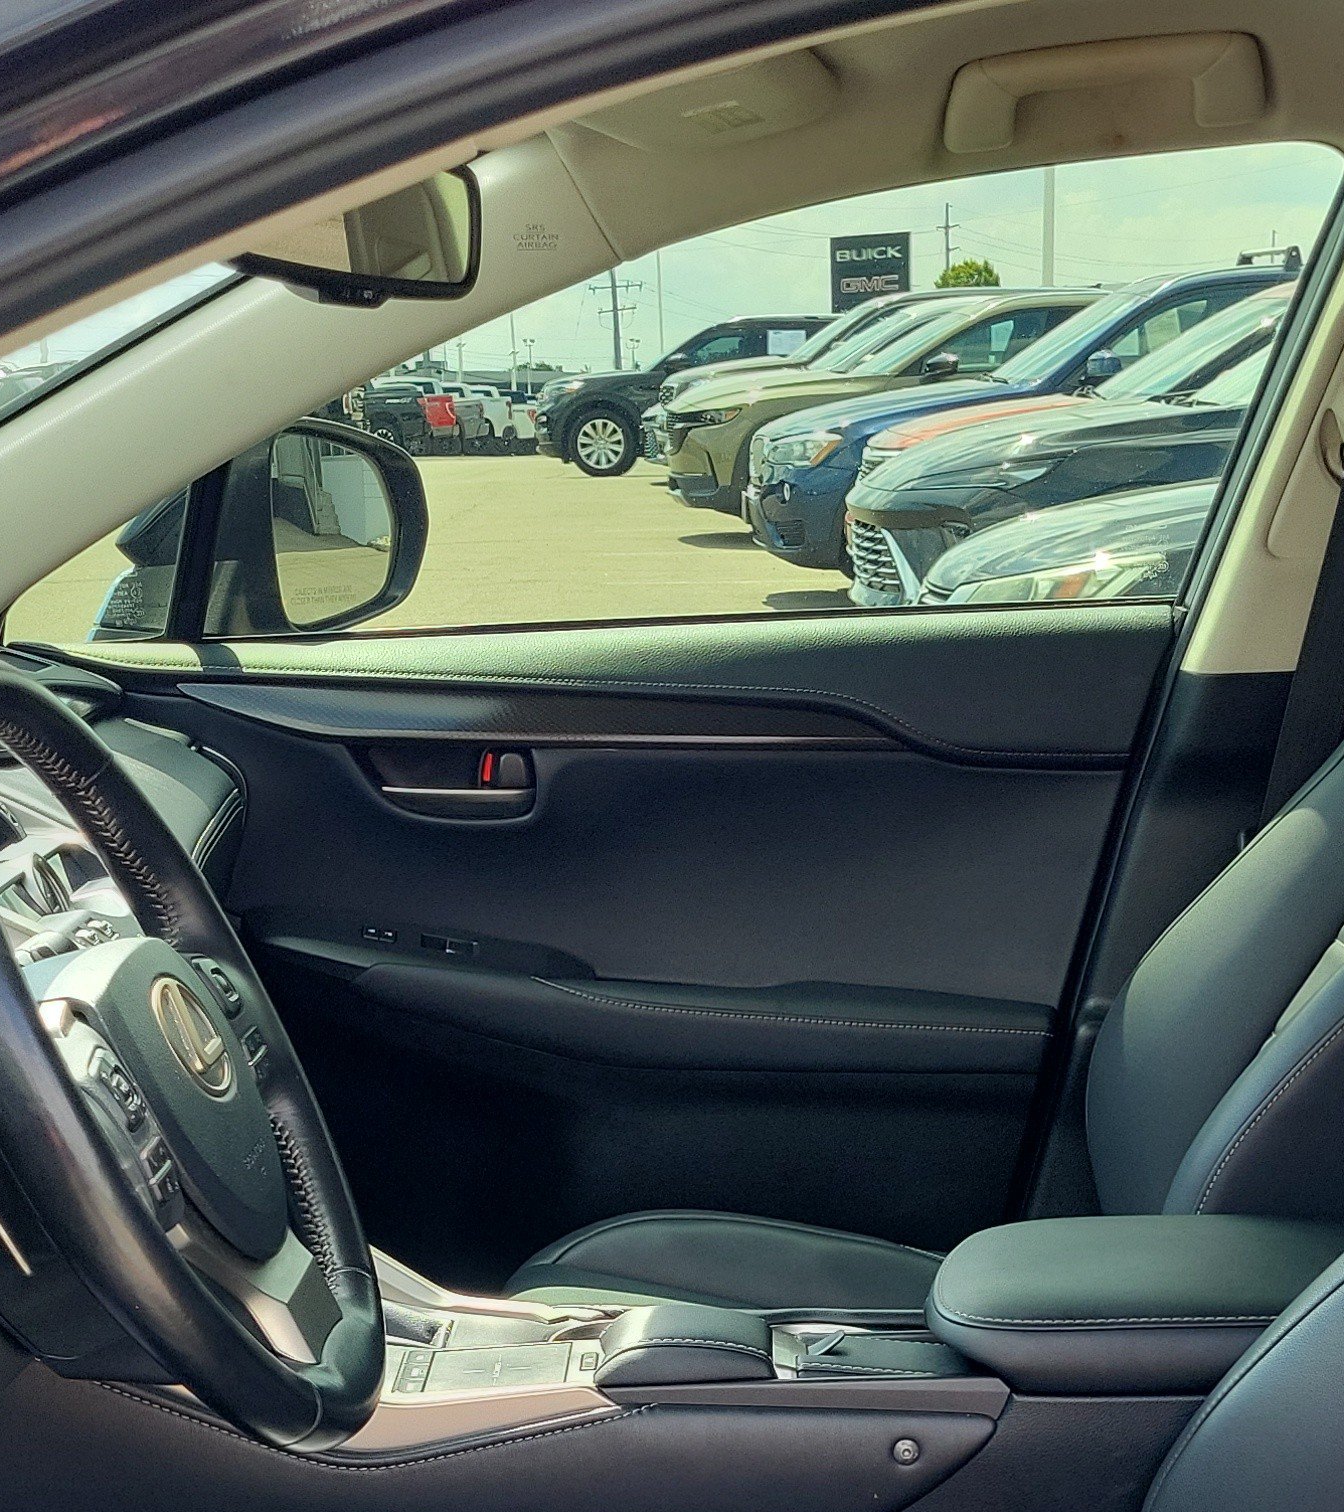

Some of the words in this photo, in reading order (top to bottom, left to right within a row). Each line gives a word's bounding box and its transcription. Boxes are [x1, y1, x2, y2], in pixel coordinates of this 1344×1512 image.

[512, 233, 559, 241] CURTAIN
[836, 246, 903, 262] BUICK
[840, 274, 899, 294] GMC
